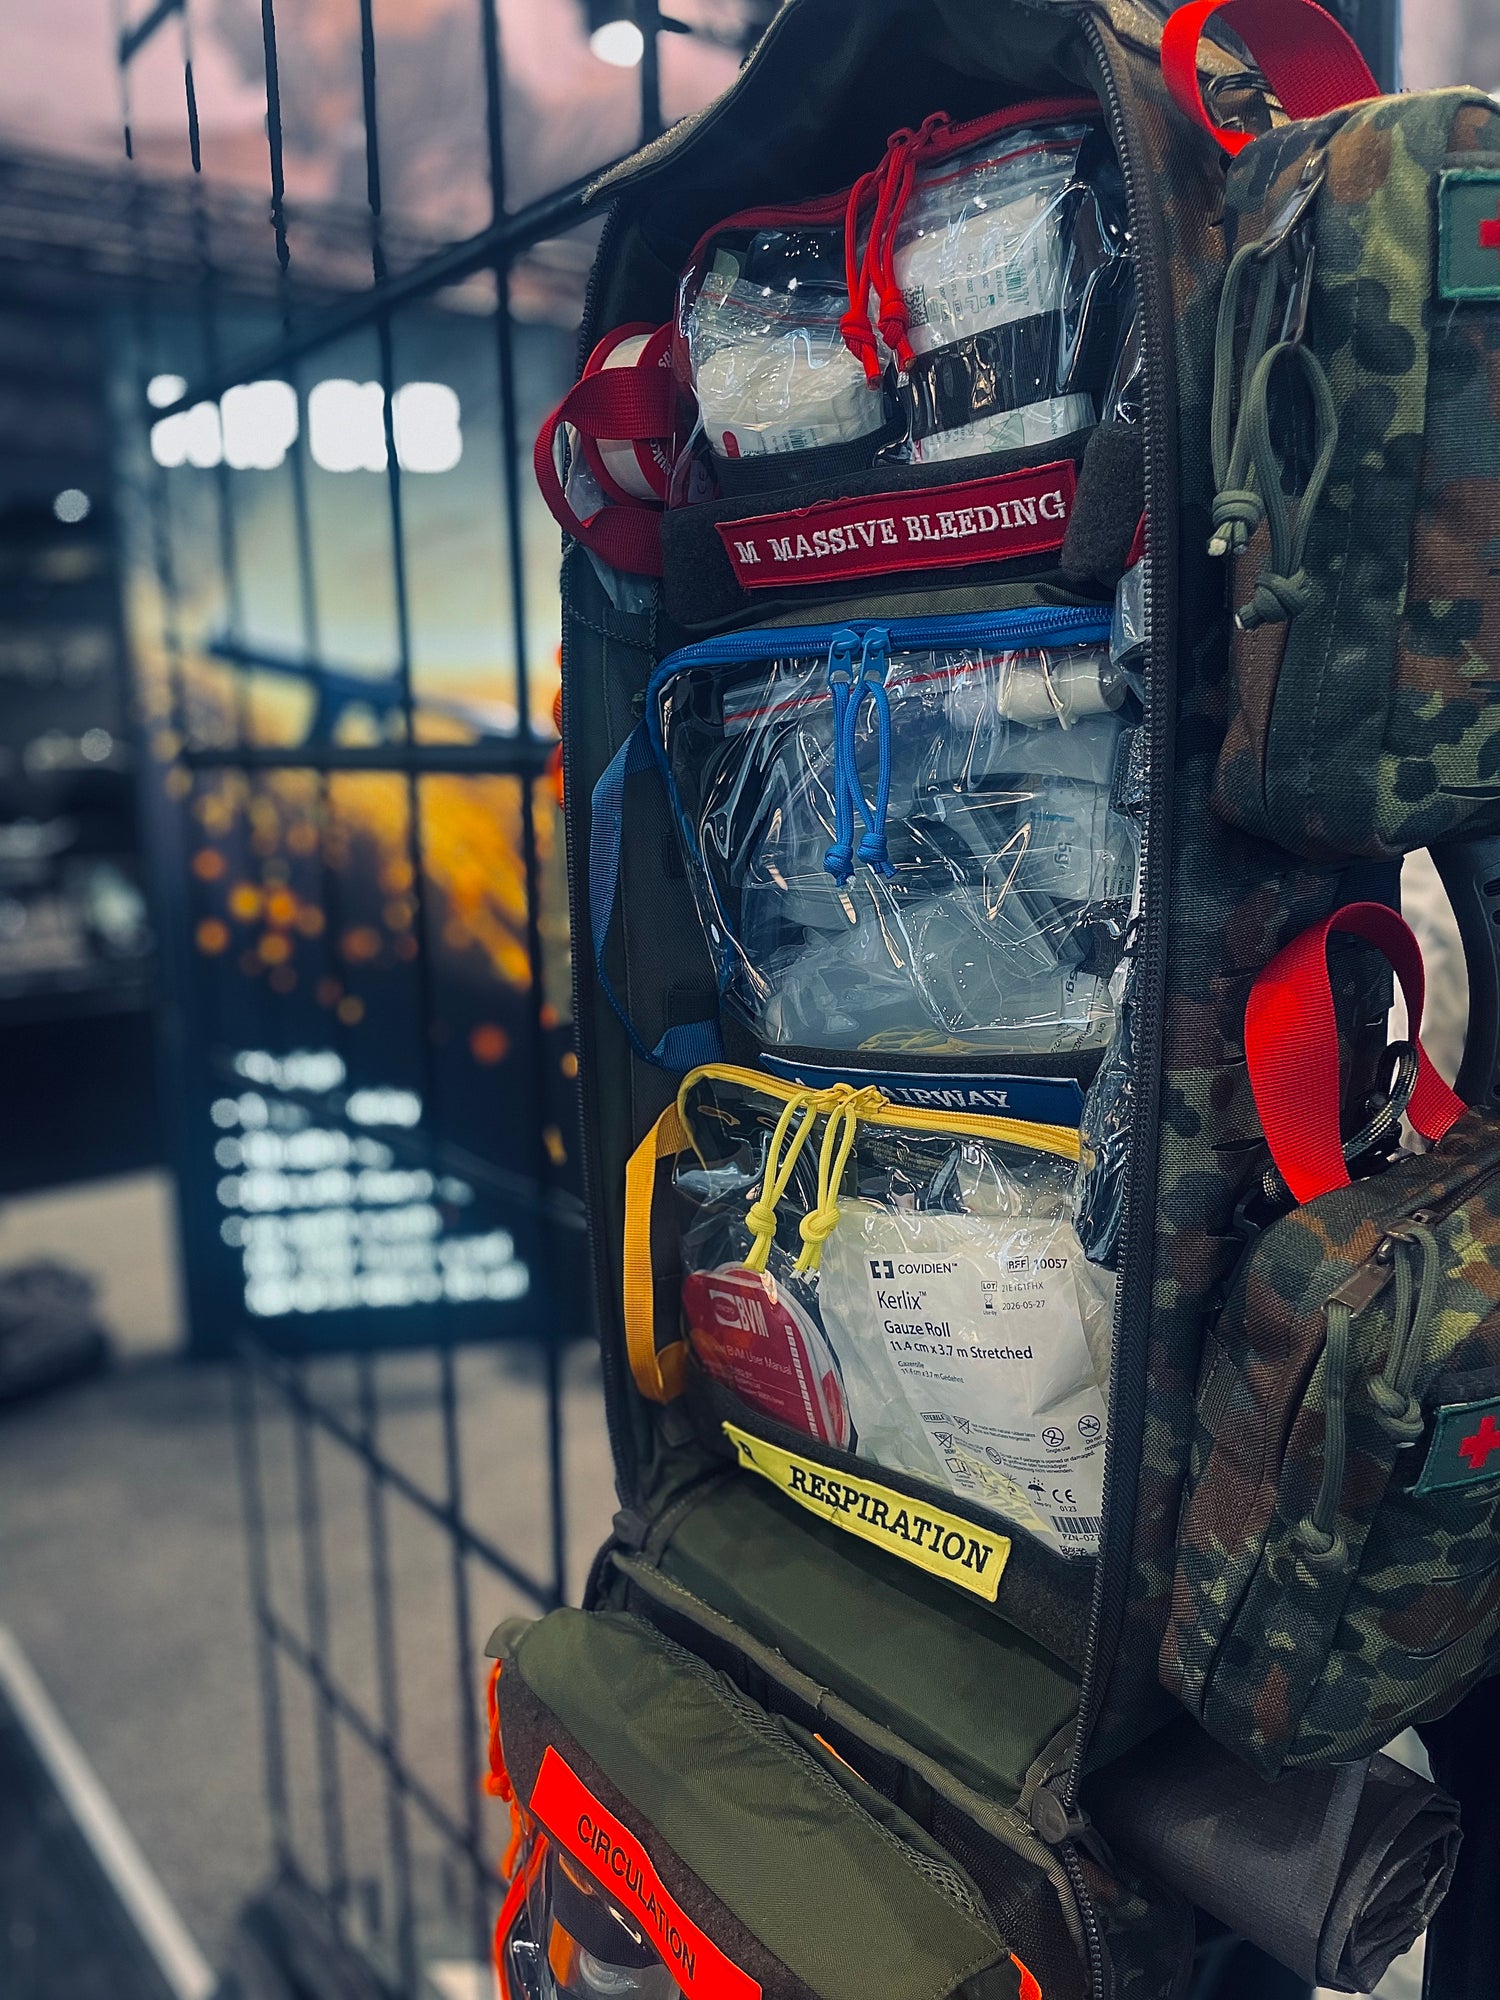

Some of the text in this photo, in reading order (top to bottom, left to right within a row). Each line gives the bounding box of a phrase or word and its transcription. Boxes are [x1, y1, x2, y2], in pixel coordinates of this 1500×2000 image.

[733, 490, 1067, 565] M MASSIVE BLEEDING
[880, 1085, 1011, 1109] AIRWAY
[735, 1296, 770, 1338] BVM
[1002, 1300, 1046, 1311] 2026-05-27
[883, 1320, 951, 1338] Gauze Roll
[889, 1340, 1034, 1360] 11.4 cm x 3.7 m Stretched
[788, 1464, 993, 1574] RESPIRATION
[577, 1814, 697, 1981] CIRCULATION
